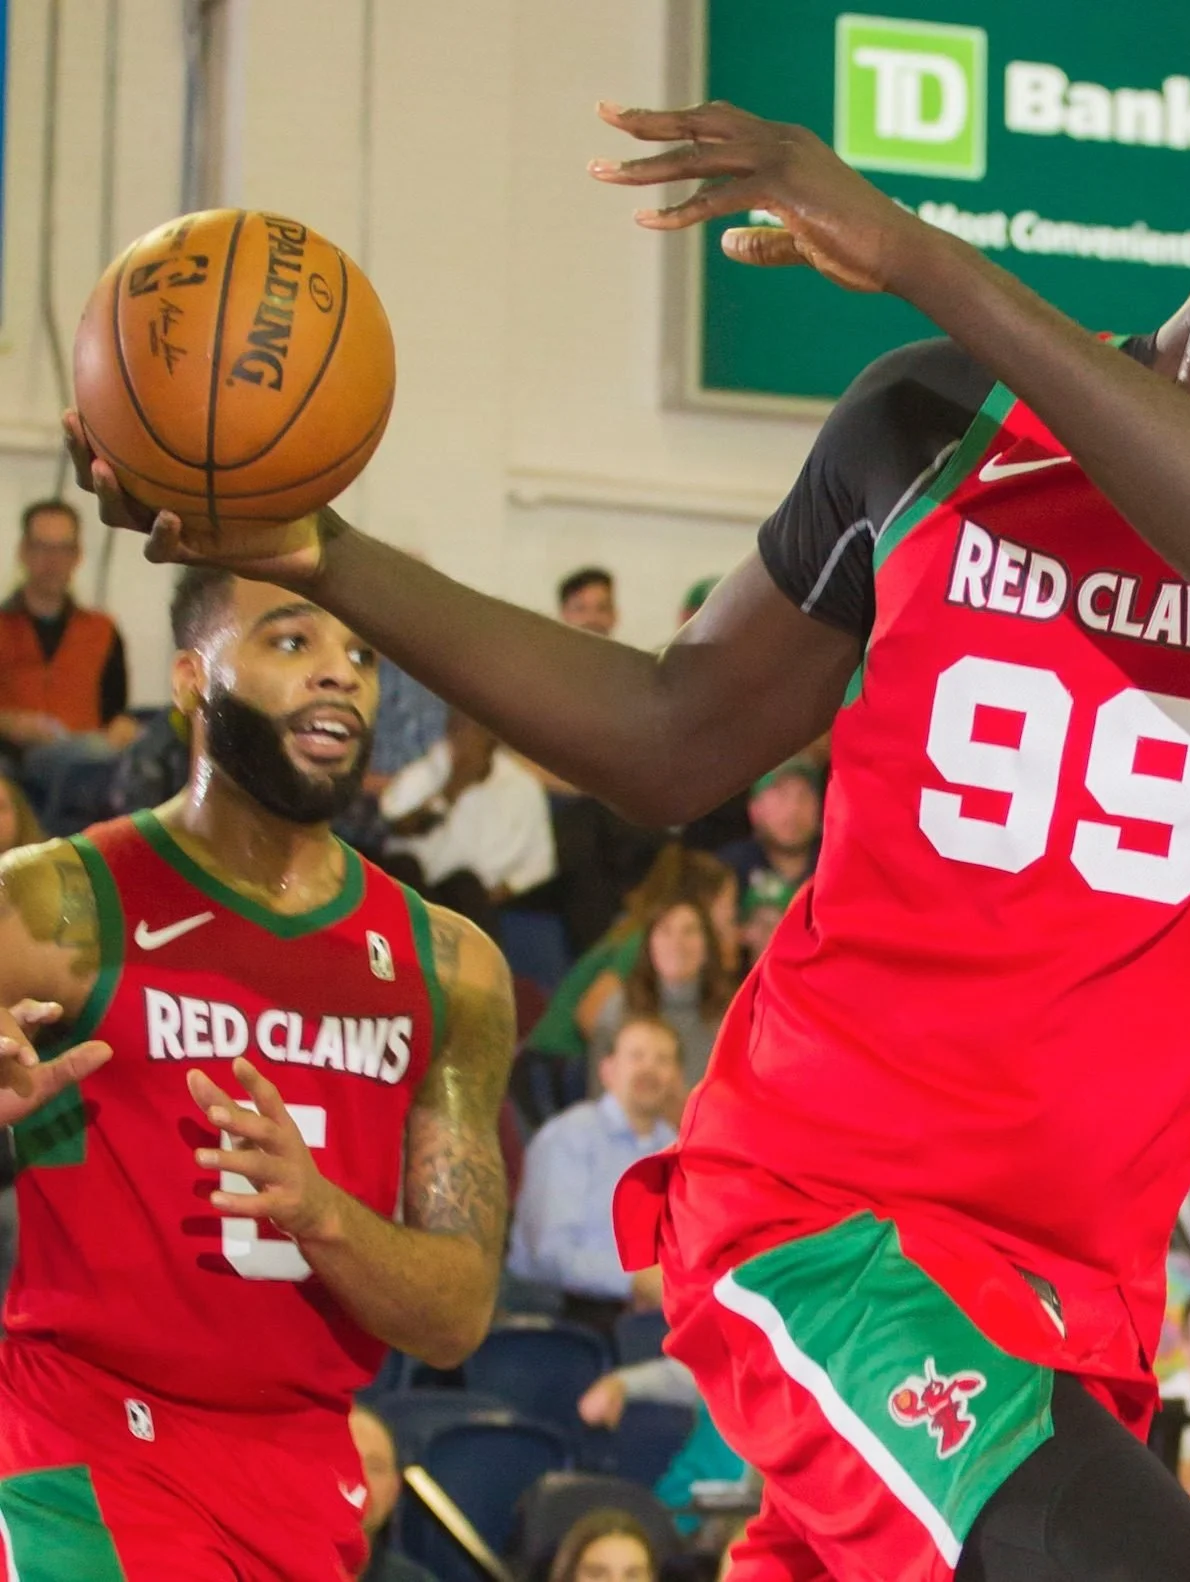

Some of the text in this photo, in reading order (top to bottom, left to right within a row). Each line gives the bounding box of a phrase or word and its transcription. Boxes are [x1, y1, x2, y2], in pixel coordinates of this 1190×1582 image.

[853, 46, 968, 144] TD
[948, 520, 1068, 620] RED
[144, 987, 413, 1085] RED CLAWS
